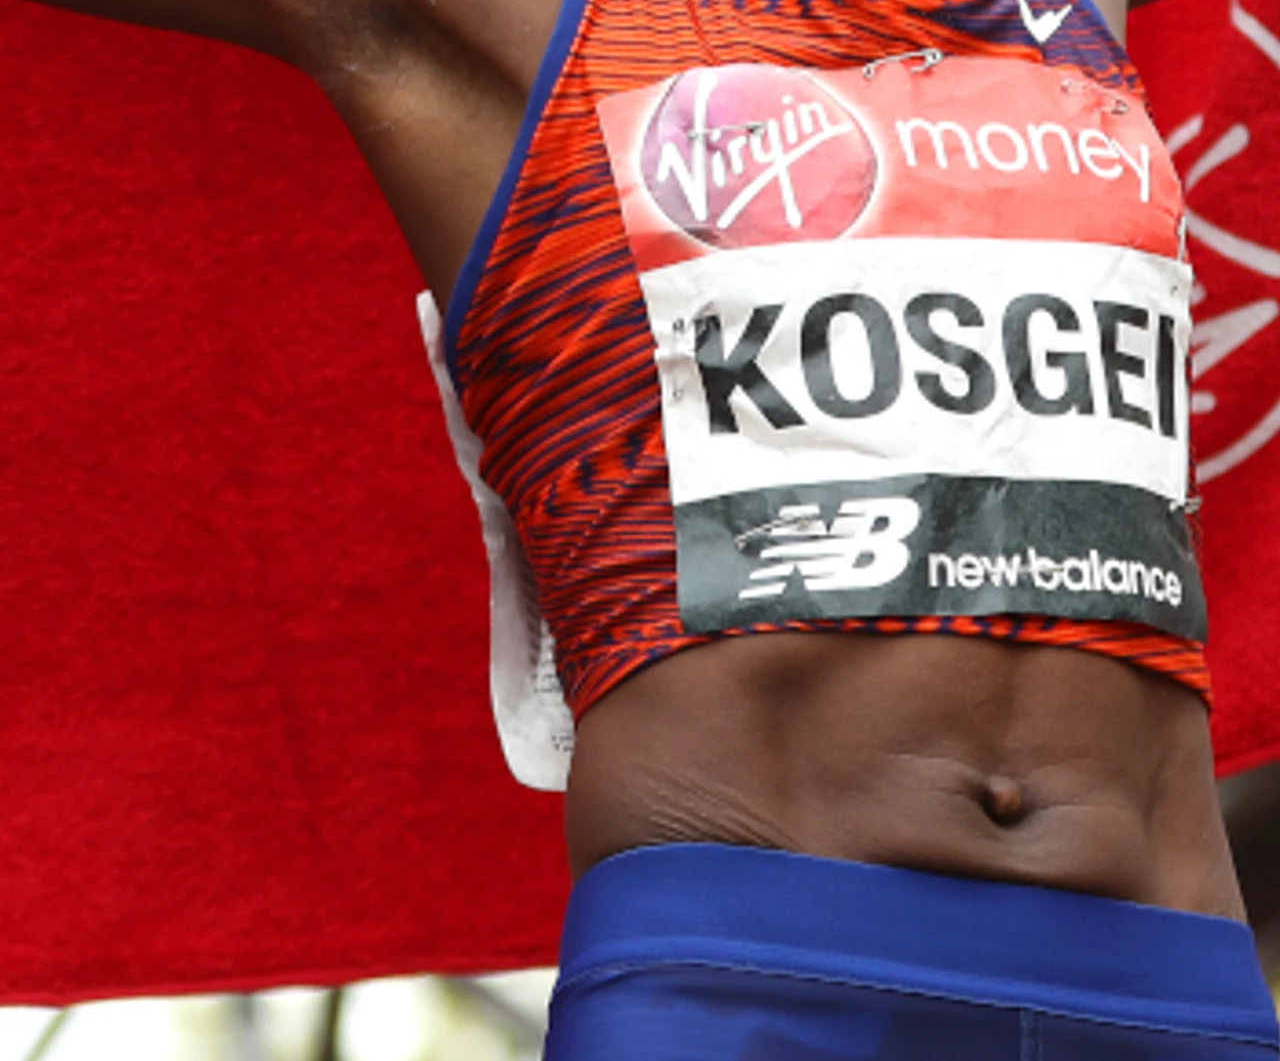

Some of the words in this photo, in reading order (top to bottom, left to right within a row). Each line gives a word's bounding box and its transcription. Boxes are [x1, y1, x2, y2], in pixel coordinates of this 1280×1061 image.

[656, 68, 855, 229] Virgin
[895, 116, 1150, 203] money
[694, 292, 1179, 441] KOSGEI
[927, 548, 1020, 590] new
[1030, 548, 1184, 607] balance
